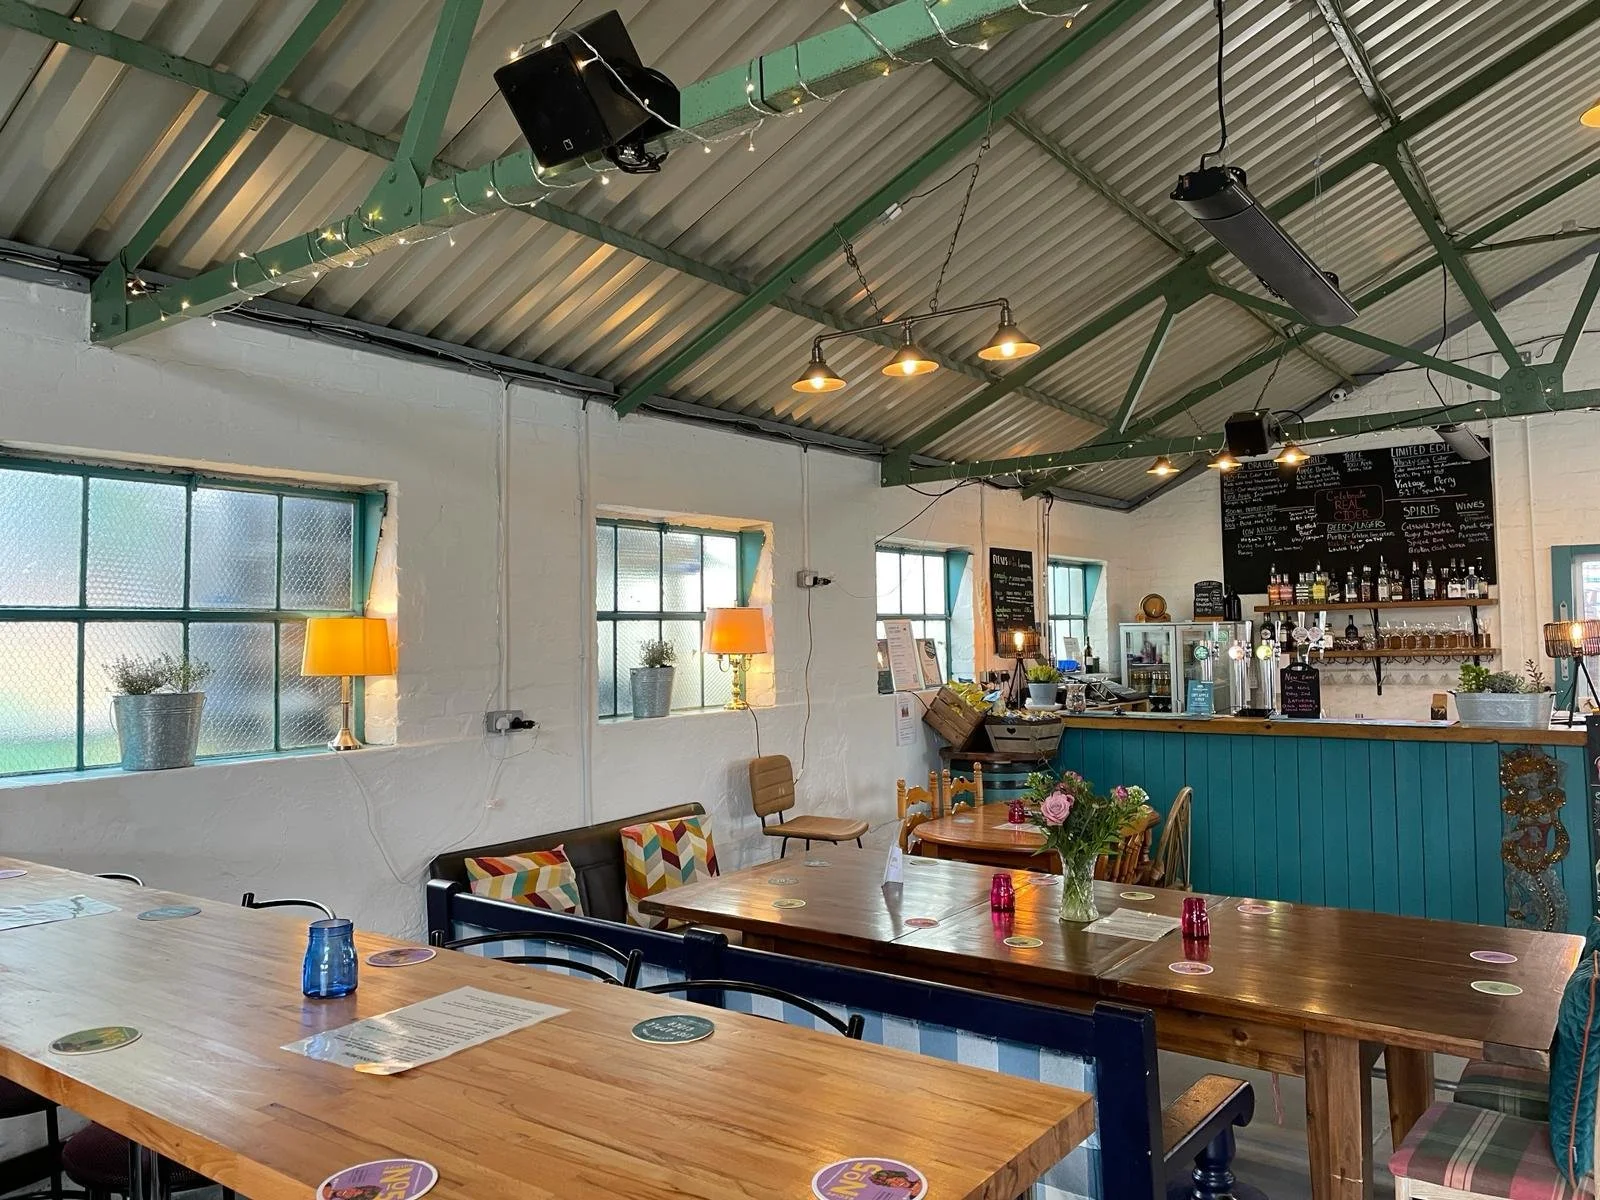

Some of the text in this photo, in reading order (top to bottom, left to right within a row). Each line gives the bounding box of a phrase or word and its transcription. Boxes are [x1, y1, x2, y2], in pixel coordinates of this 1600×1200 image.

[1391, 446, 1426, 458] LIMITED
[1395, 476, 1457, 490] Vintage Perry
[1335, 499, 1361, 510] REAL
[1403, 504, 1441, 517] SPIRITS
[1455, 500, 1485, 512] WINES
[1333, 509, 1371, 521] CIDER
[1327, 521, 1386, 532] BEERS/LAGERS
